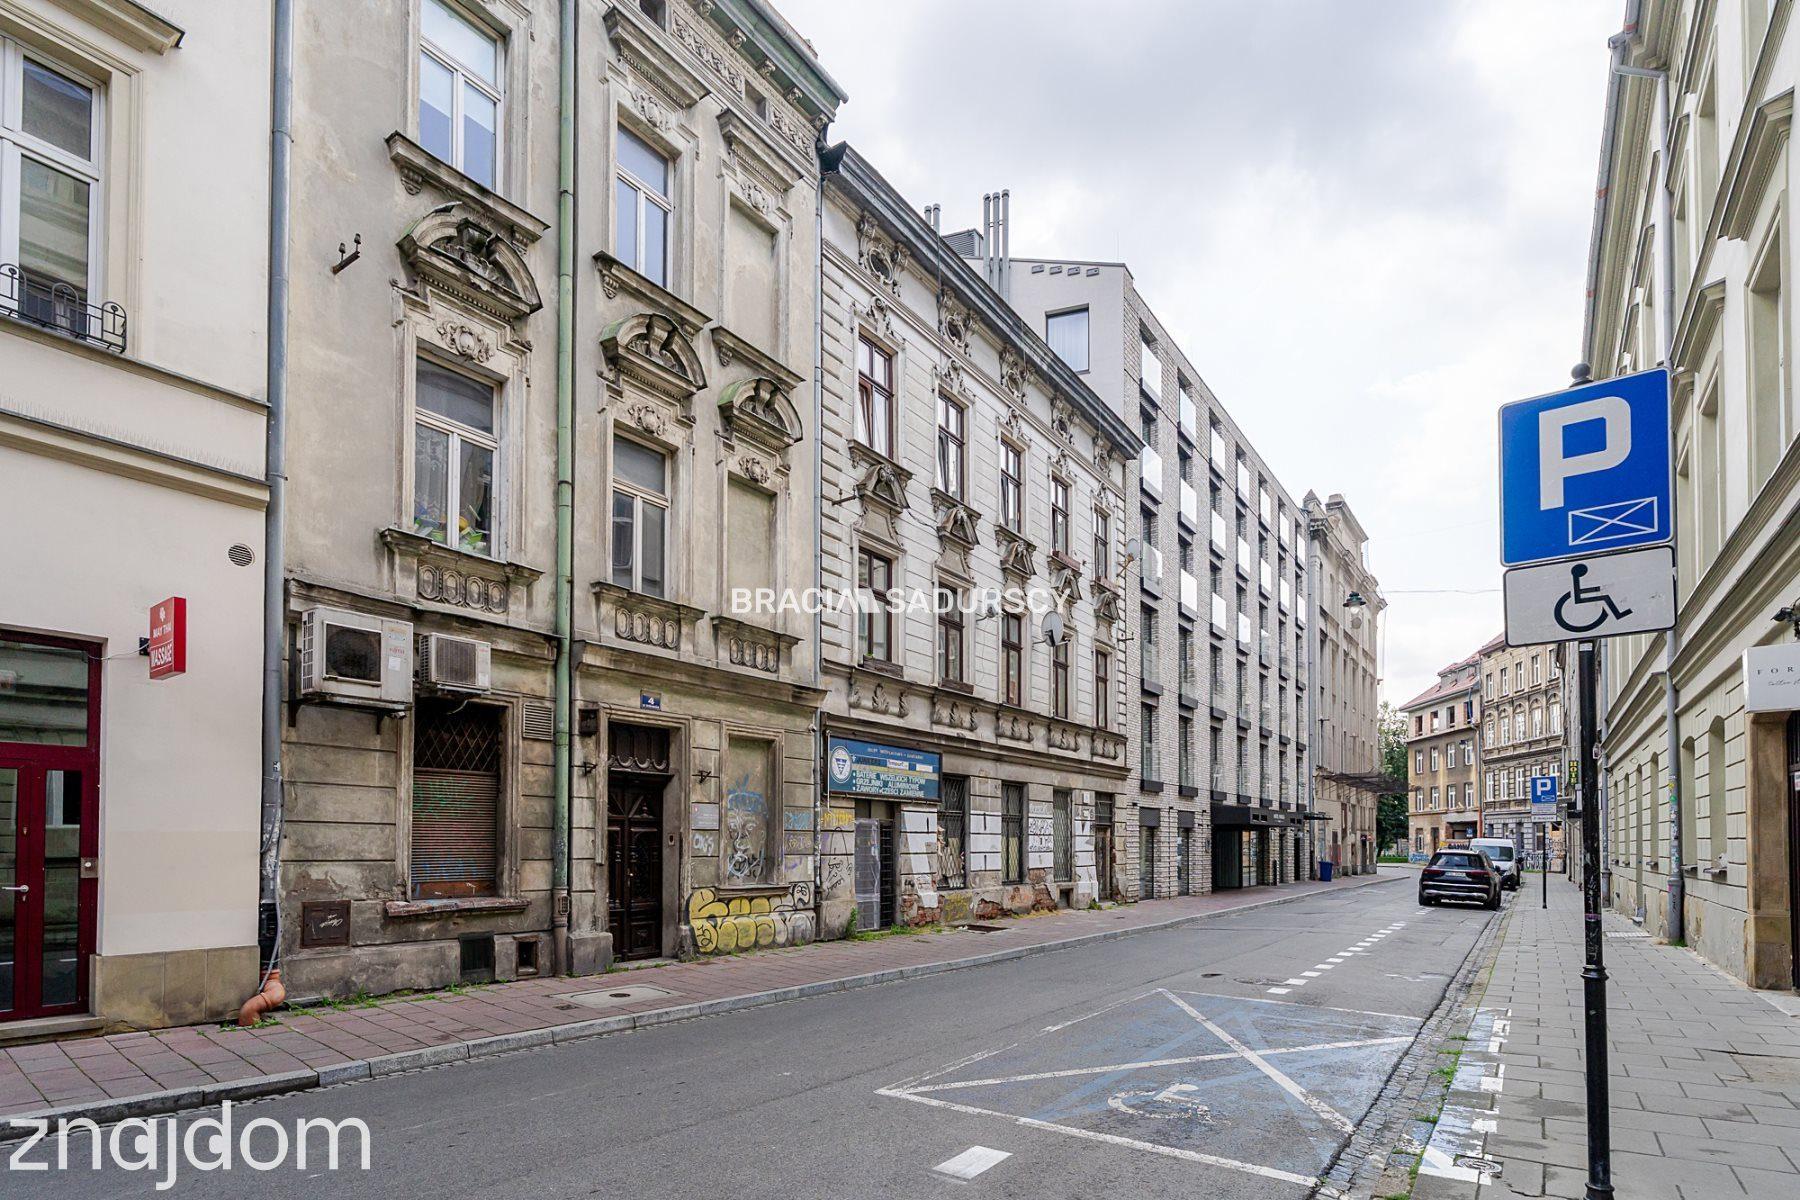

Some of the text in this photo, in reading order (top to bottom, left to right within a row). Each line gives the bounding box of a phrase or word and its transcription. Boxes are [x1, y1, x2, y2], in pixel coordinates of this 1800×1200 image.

[1538, 396, 1632, 511] P
[150, 642, 173, 667] MASSAGE
[1536, 779, 1551, 796] P
